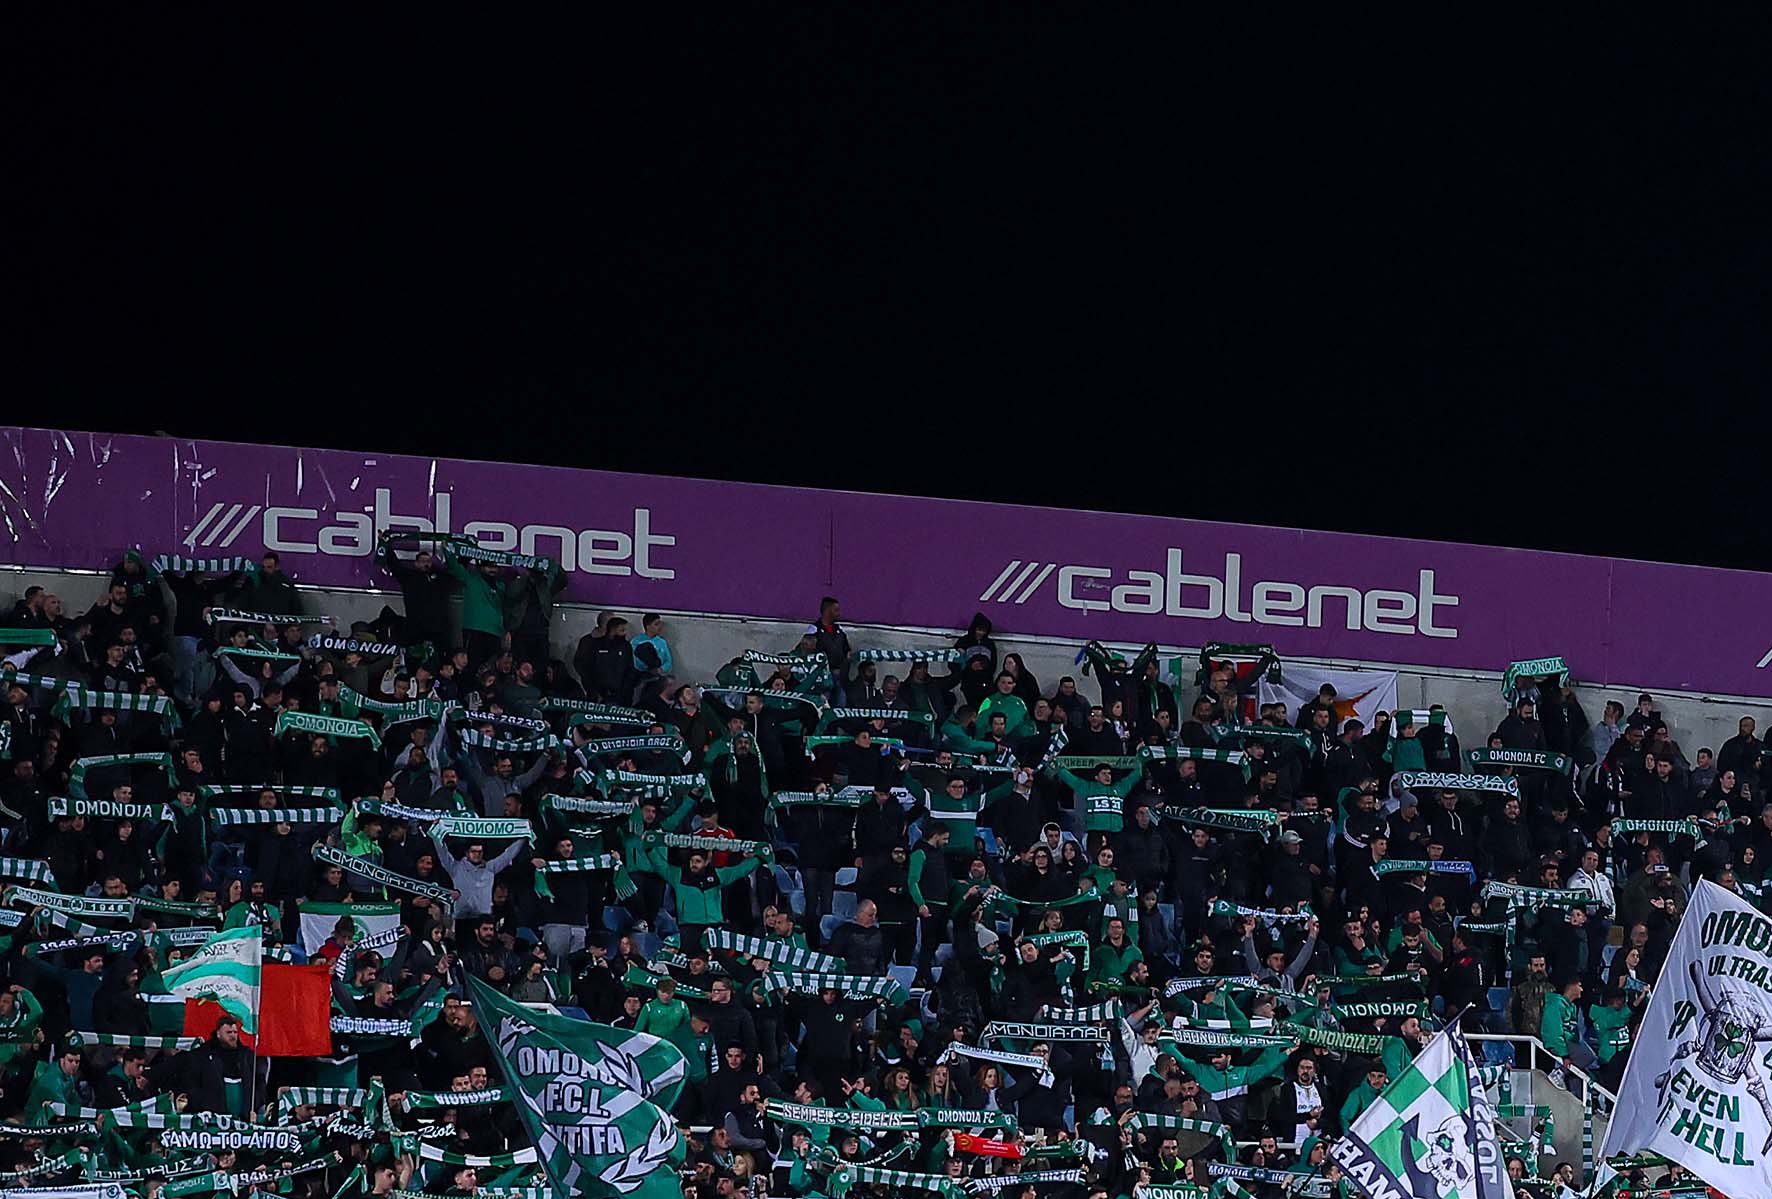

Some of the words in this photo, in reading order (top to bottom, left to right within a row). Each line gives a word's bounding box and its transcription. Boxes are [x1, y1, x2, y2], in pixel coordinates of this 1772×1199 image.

[263, 489, 676, 580] cablenet
[1057, 548, 1459, 638] cablenet
[807, 653, 825, 664] FC
[295, 716, 358, 736] OMONOIA
[1489, 752, 1532, 764] OMONOIA
[1534, 754, 1547, 766] FC
[75, 799, 154, 819] OMONOIA
[1626, 819, 1685, 834] OMONOIA
[1670, 1067, 1741, 1122] EVEN
[938, 1109, 982, 1125] OMONOIA
[983, 1111, 997, 1125] FC
[1670, 1108, 1755, 1165] HELL
